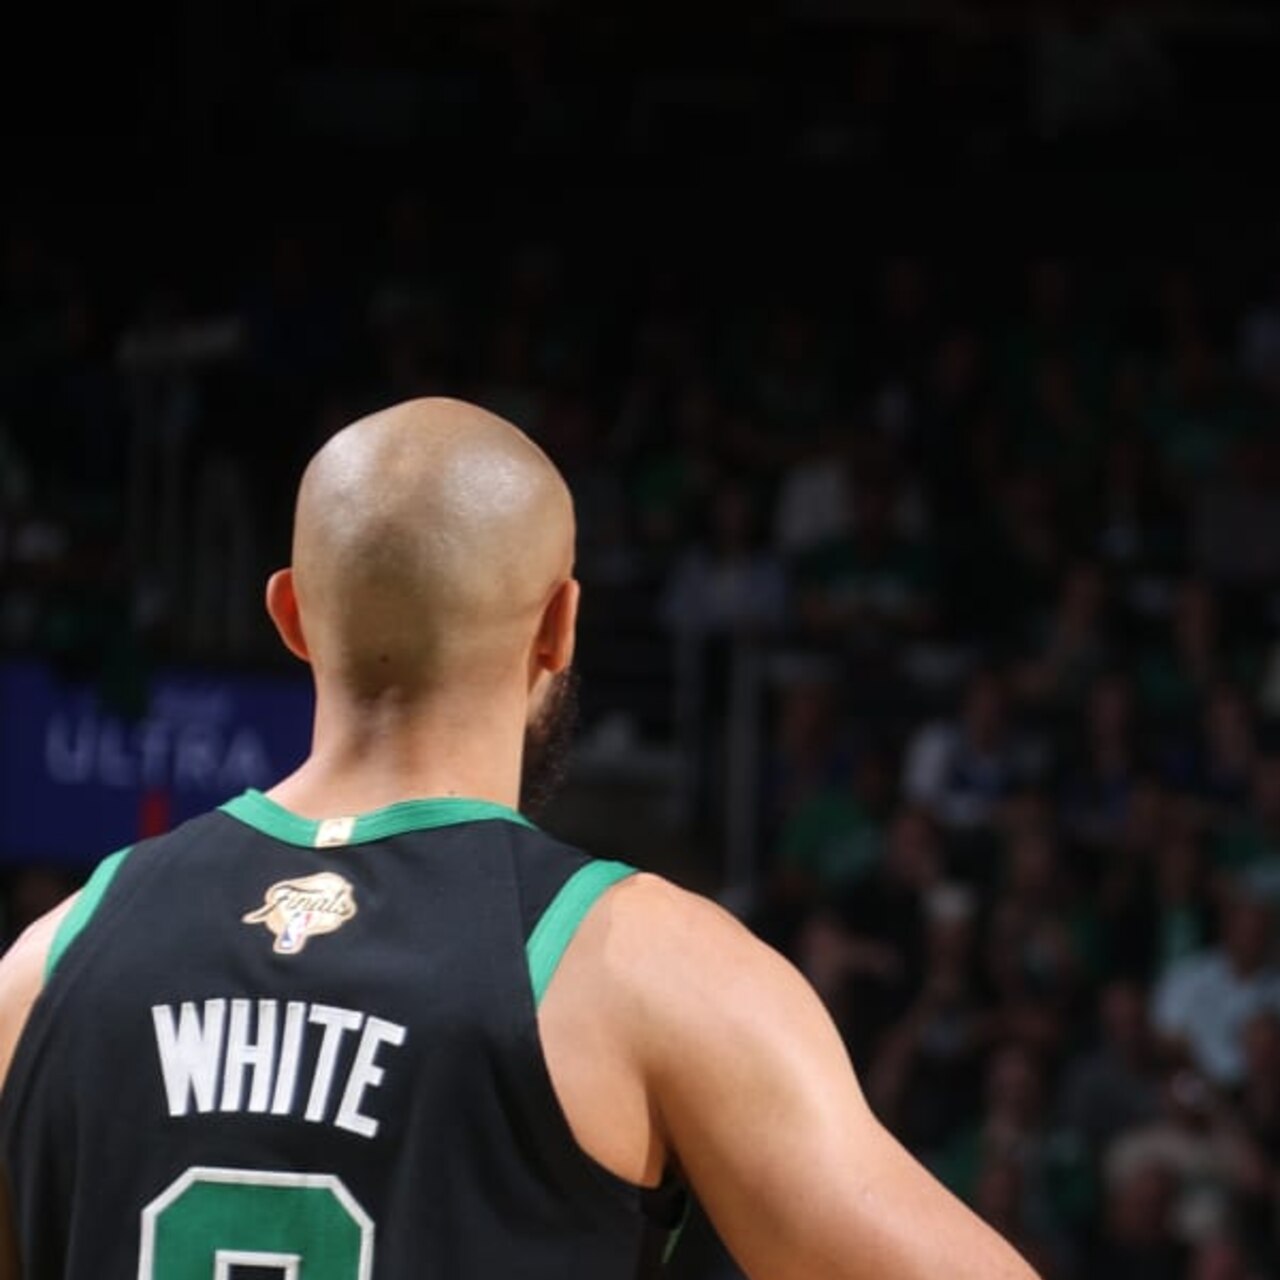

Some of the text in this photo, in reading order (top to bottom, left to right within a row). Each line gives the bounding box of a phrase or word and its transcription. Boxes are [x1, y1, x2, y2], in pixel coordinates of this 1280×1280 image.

[45, 710, 273, 788] ULTRA
[252, 883, 350, 918] Finals
[151, 999, 406, 1138] WHITE
